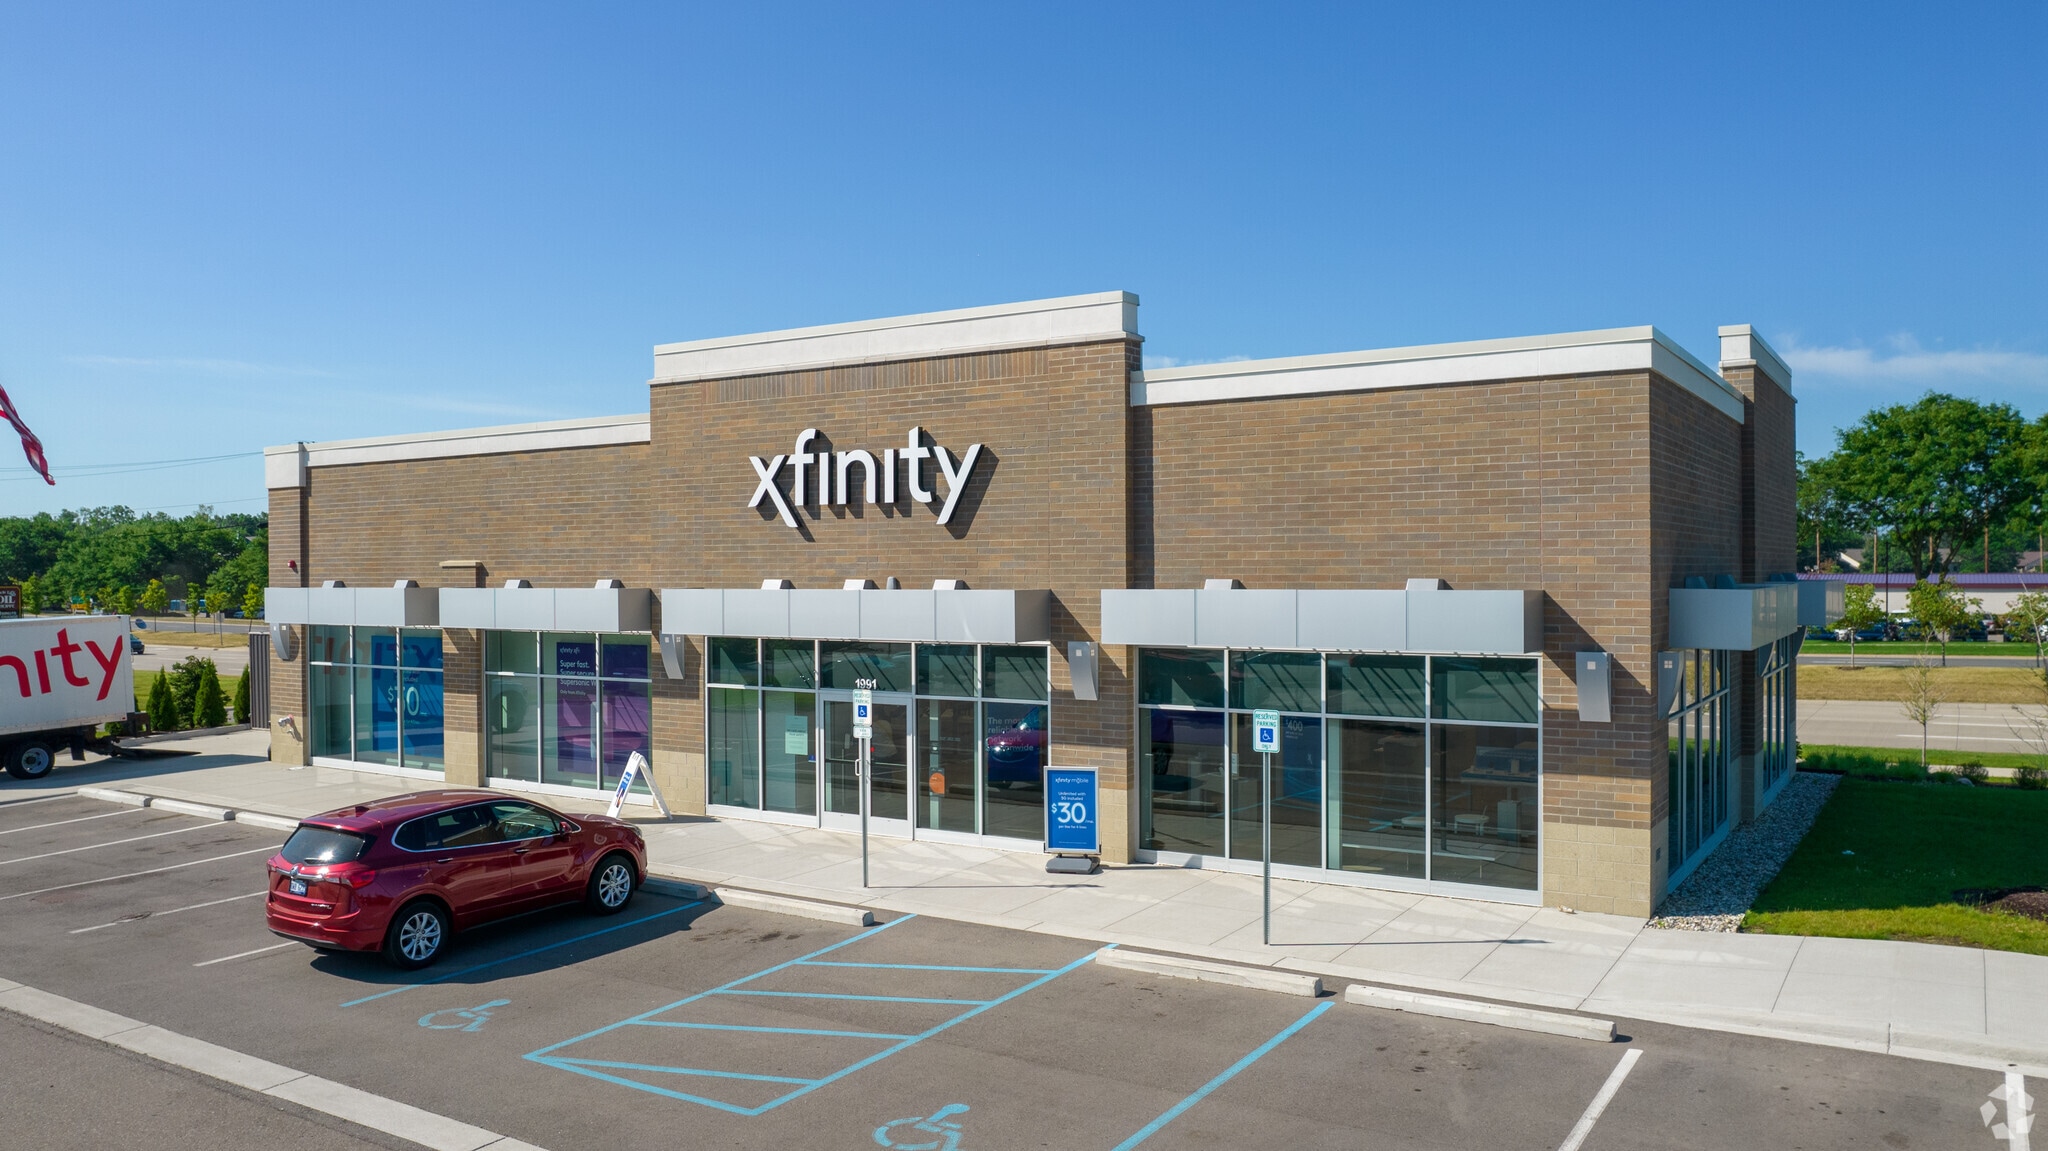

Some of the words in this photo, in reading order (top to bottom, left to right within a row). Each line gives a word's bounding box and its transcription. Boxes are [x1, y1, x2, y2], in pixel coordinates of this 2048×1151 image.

[748, 426, 983, 528] xfinity
[560, 660, 576, 669] Super
[576, 661, 590, 669] fast.
[560, 679, 590, 687] Supersonic
[855, 678, 877, 690] 1991
[987, 717, 1003, 725] The
[1255, 713, 1279, 721] RESERVED
[1285, 719, 1304, 732] $400
[988, 726, 1018, 734] reliable
[1055, 776, 1070, 784] xfinity
[1071, 776, 1089, 784] mobile
[1051, 802, 1087, 824] $30
